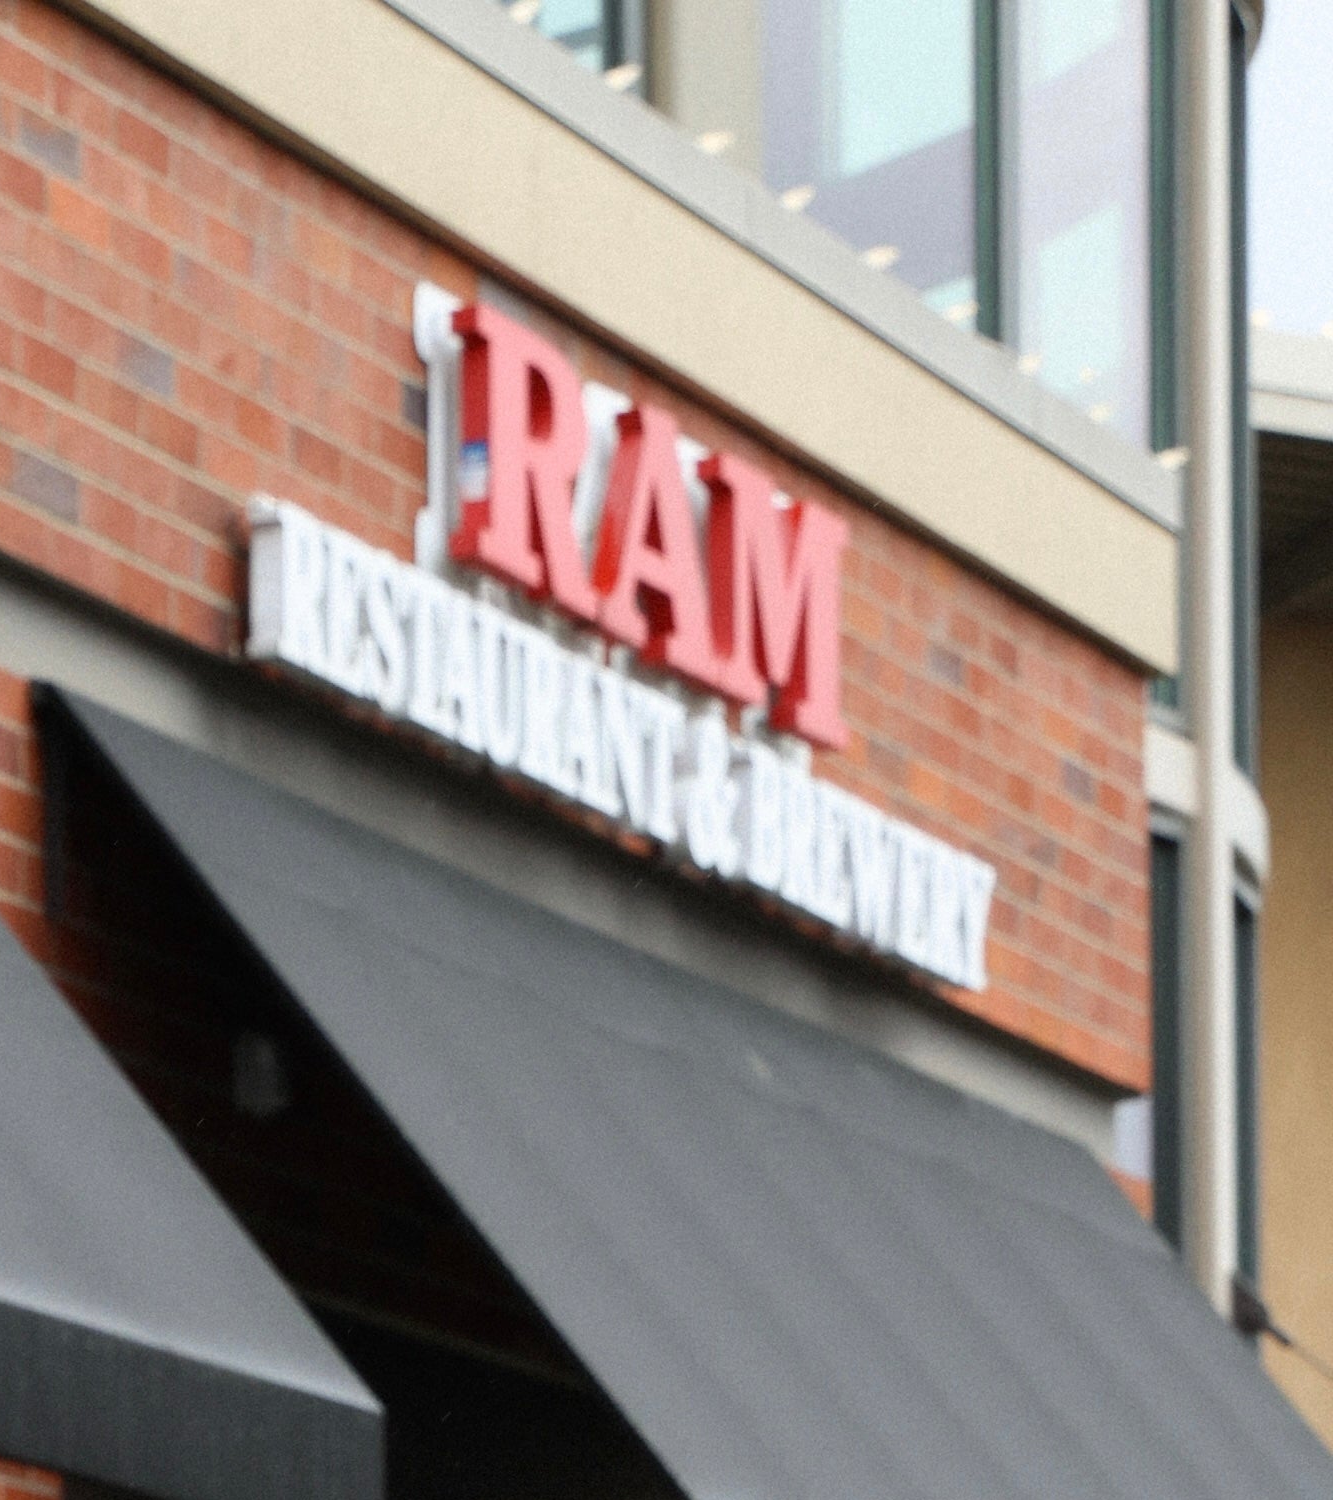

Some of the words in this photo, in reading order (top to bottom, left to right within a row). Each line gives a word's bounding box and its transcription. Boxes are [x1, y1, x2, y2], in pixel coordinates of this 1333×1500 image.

[253, 498, 686, 845] RESTAURANT
[747, 738, 998, 992] BREWERY
[449, 302, 851, 750] RAM
